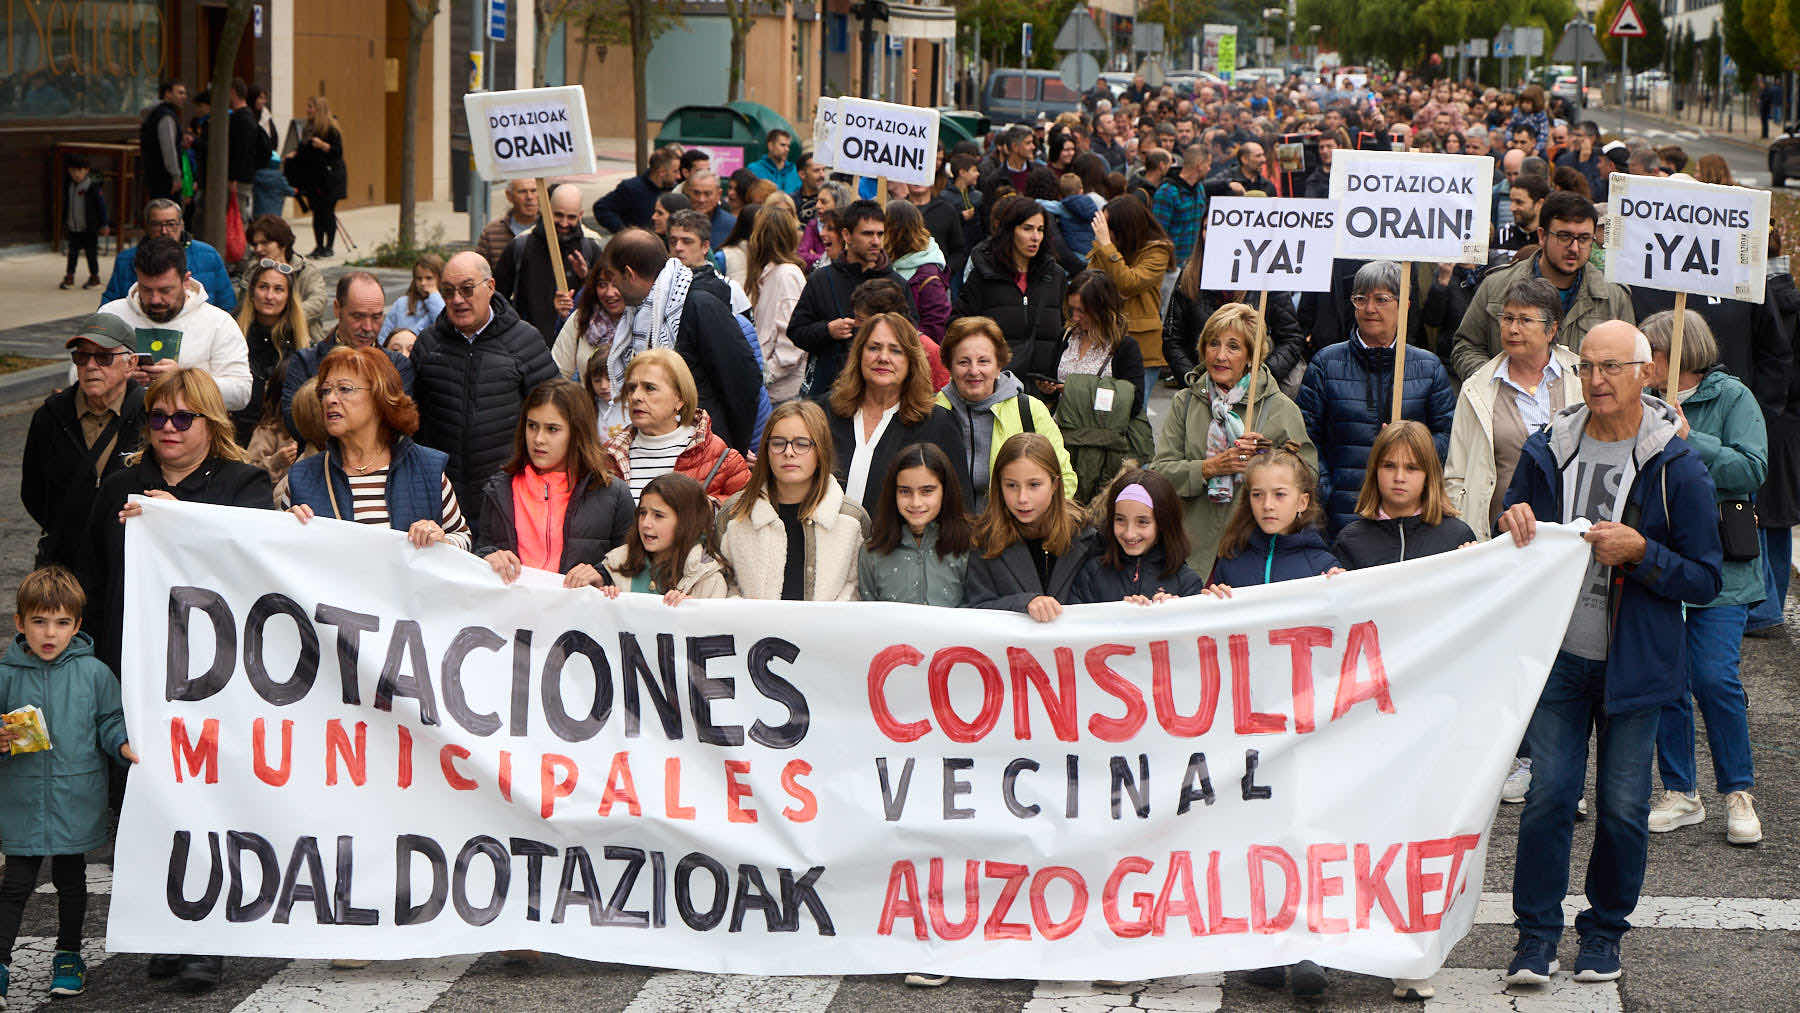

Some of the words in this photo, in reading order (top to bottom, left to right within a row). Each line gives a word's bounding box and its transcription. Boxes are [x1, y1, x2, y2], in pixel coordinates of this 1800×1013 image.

[489, 109, 567, 128] DOTAZIOAK
[845, 113, 927, 139] DOTAZIOAK
[495, 131, 573, 159] ORAIN!
[843, 137, 924, 170] ORAIN!
[1347, 174, 1473, 194] DOTAZIOAK
[1211, 209, 1334, 228] DOTACIONES
[1346, 206, 1473, 240] ORAIN!
[1620, 198, 1749, 229] DOTACIONES
[1231, 239, 1305, 282] ¡YA!
[1644, 233, 1720, 279] ¡YA!
[166, 586, 810, 749] DOTACIONES
[868, 620, 1396, 744] CONSULTA
[170, 717, 819, 823] MUNICIPALES
[876, 750, 1273, 821] VECINAL
[167, 831, 379, 926] UDAL
[396, 834, 836, 936] DOTAZIOAK
[878, 857, 1089, 941] AUZO
[1102, 833, 1481, 938] GALDEKET
